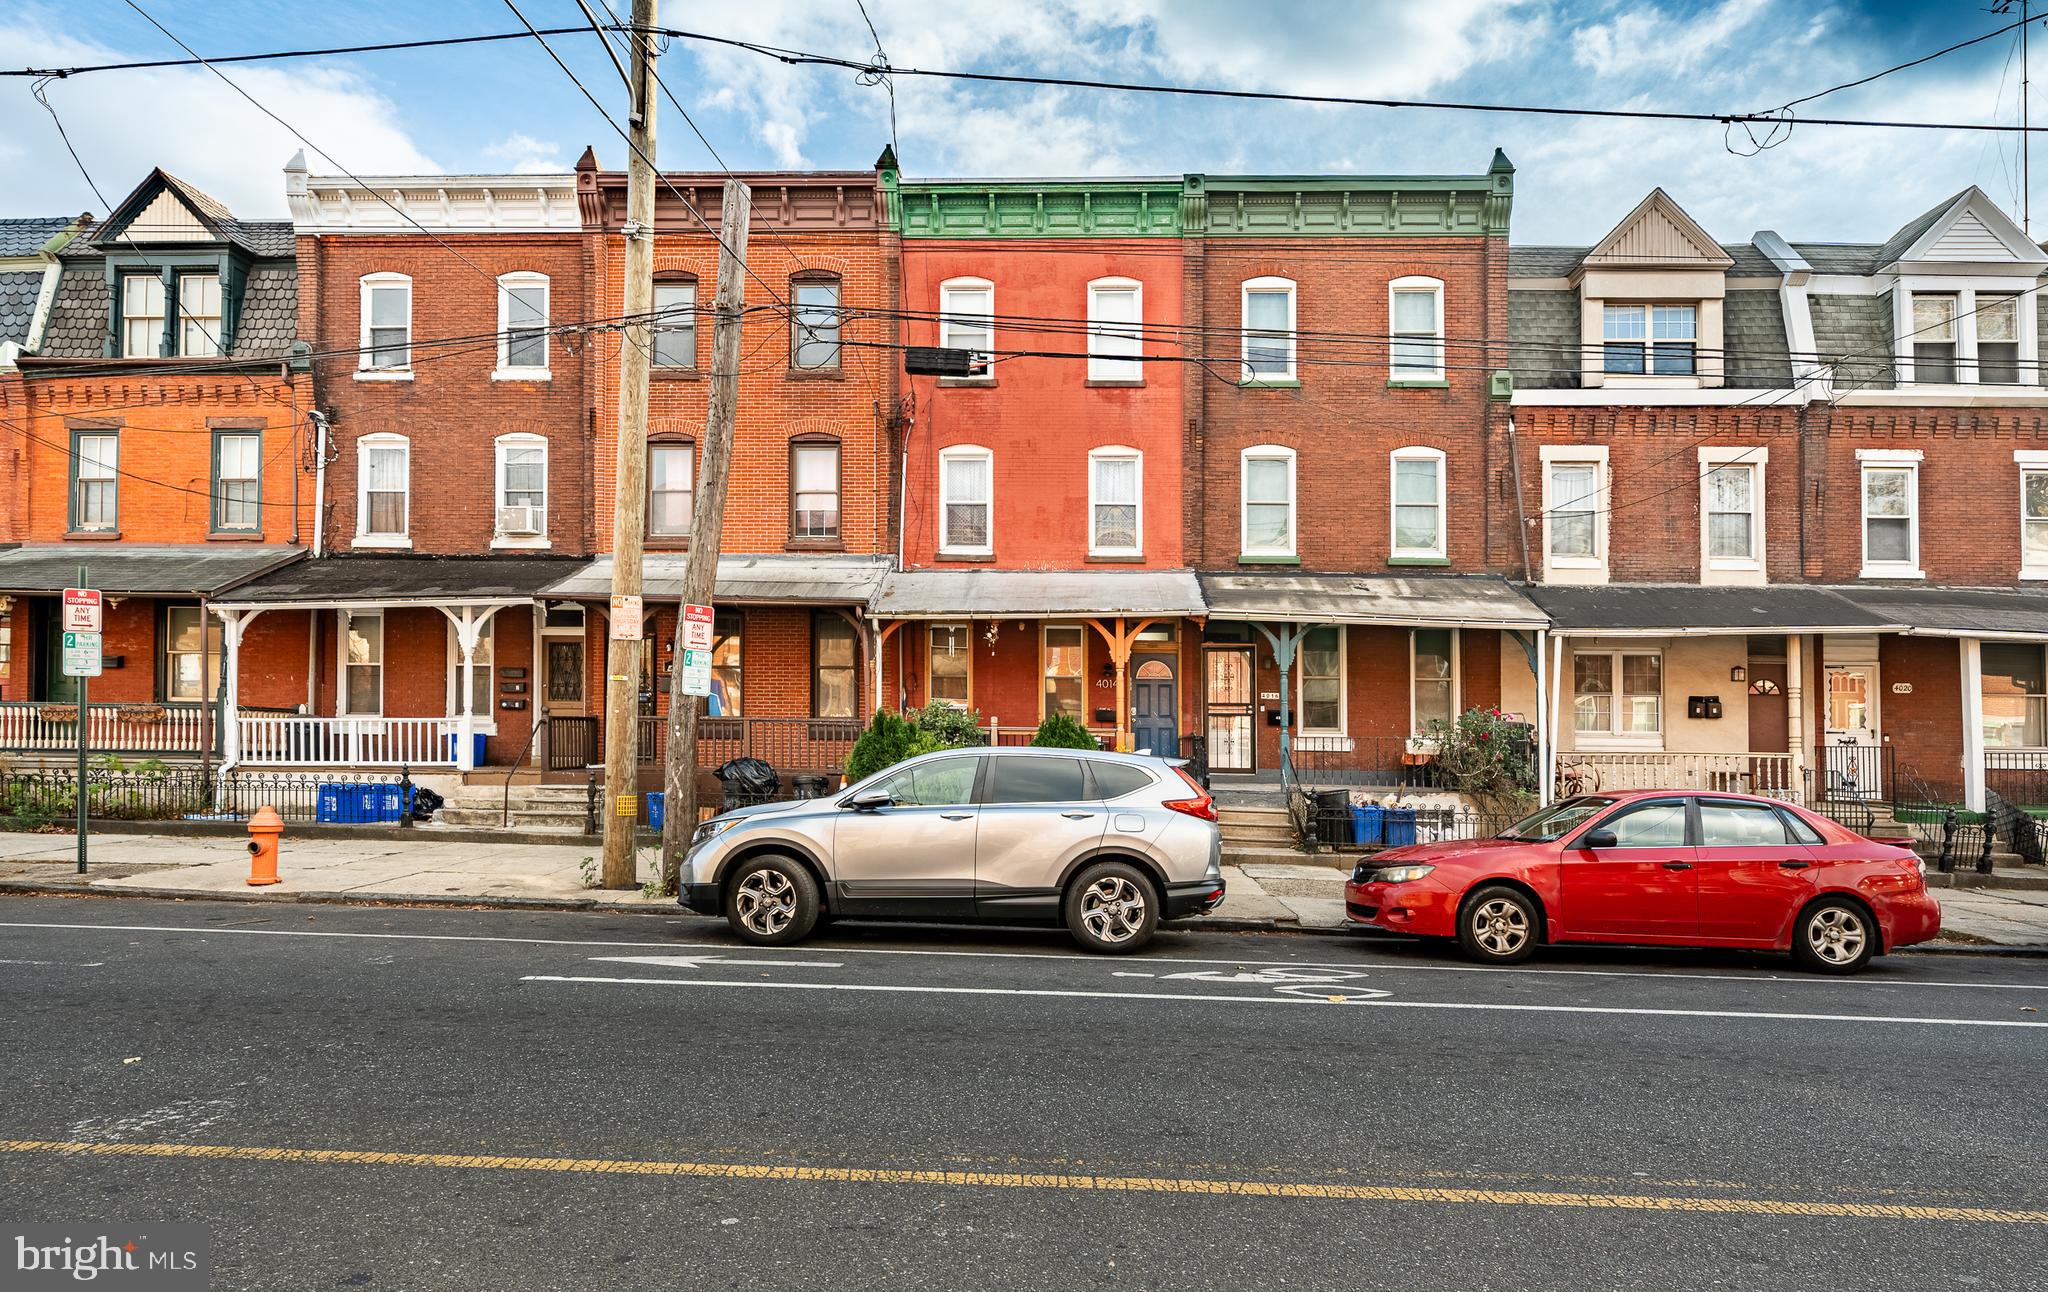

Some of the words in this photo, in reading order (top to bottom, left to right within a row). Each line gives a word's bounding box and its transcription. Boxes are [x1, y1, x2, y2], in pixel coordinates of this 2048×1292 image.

[67, 597, 98, 605] STOPPING
[612, 598, 623, 607] NO
[74, 615, 91, 623] TIME
[686, 613, 711, 621] STOPPING
[691, 631, 705, 640] TIME
[66, 635, 75, 647] 2
